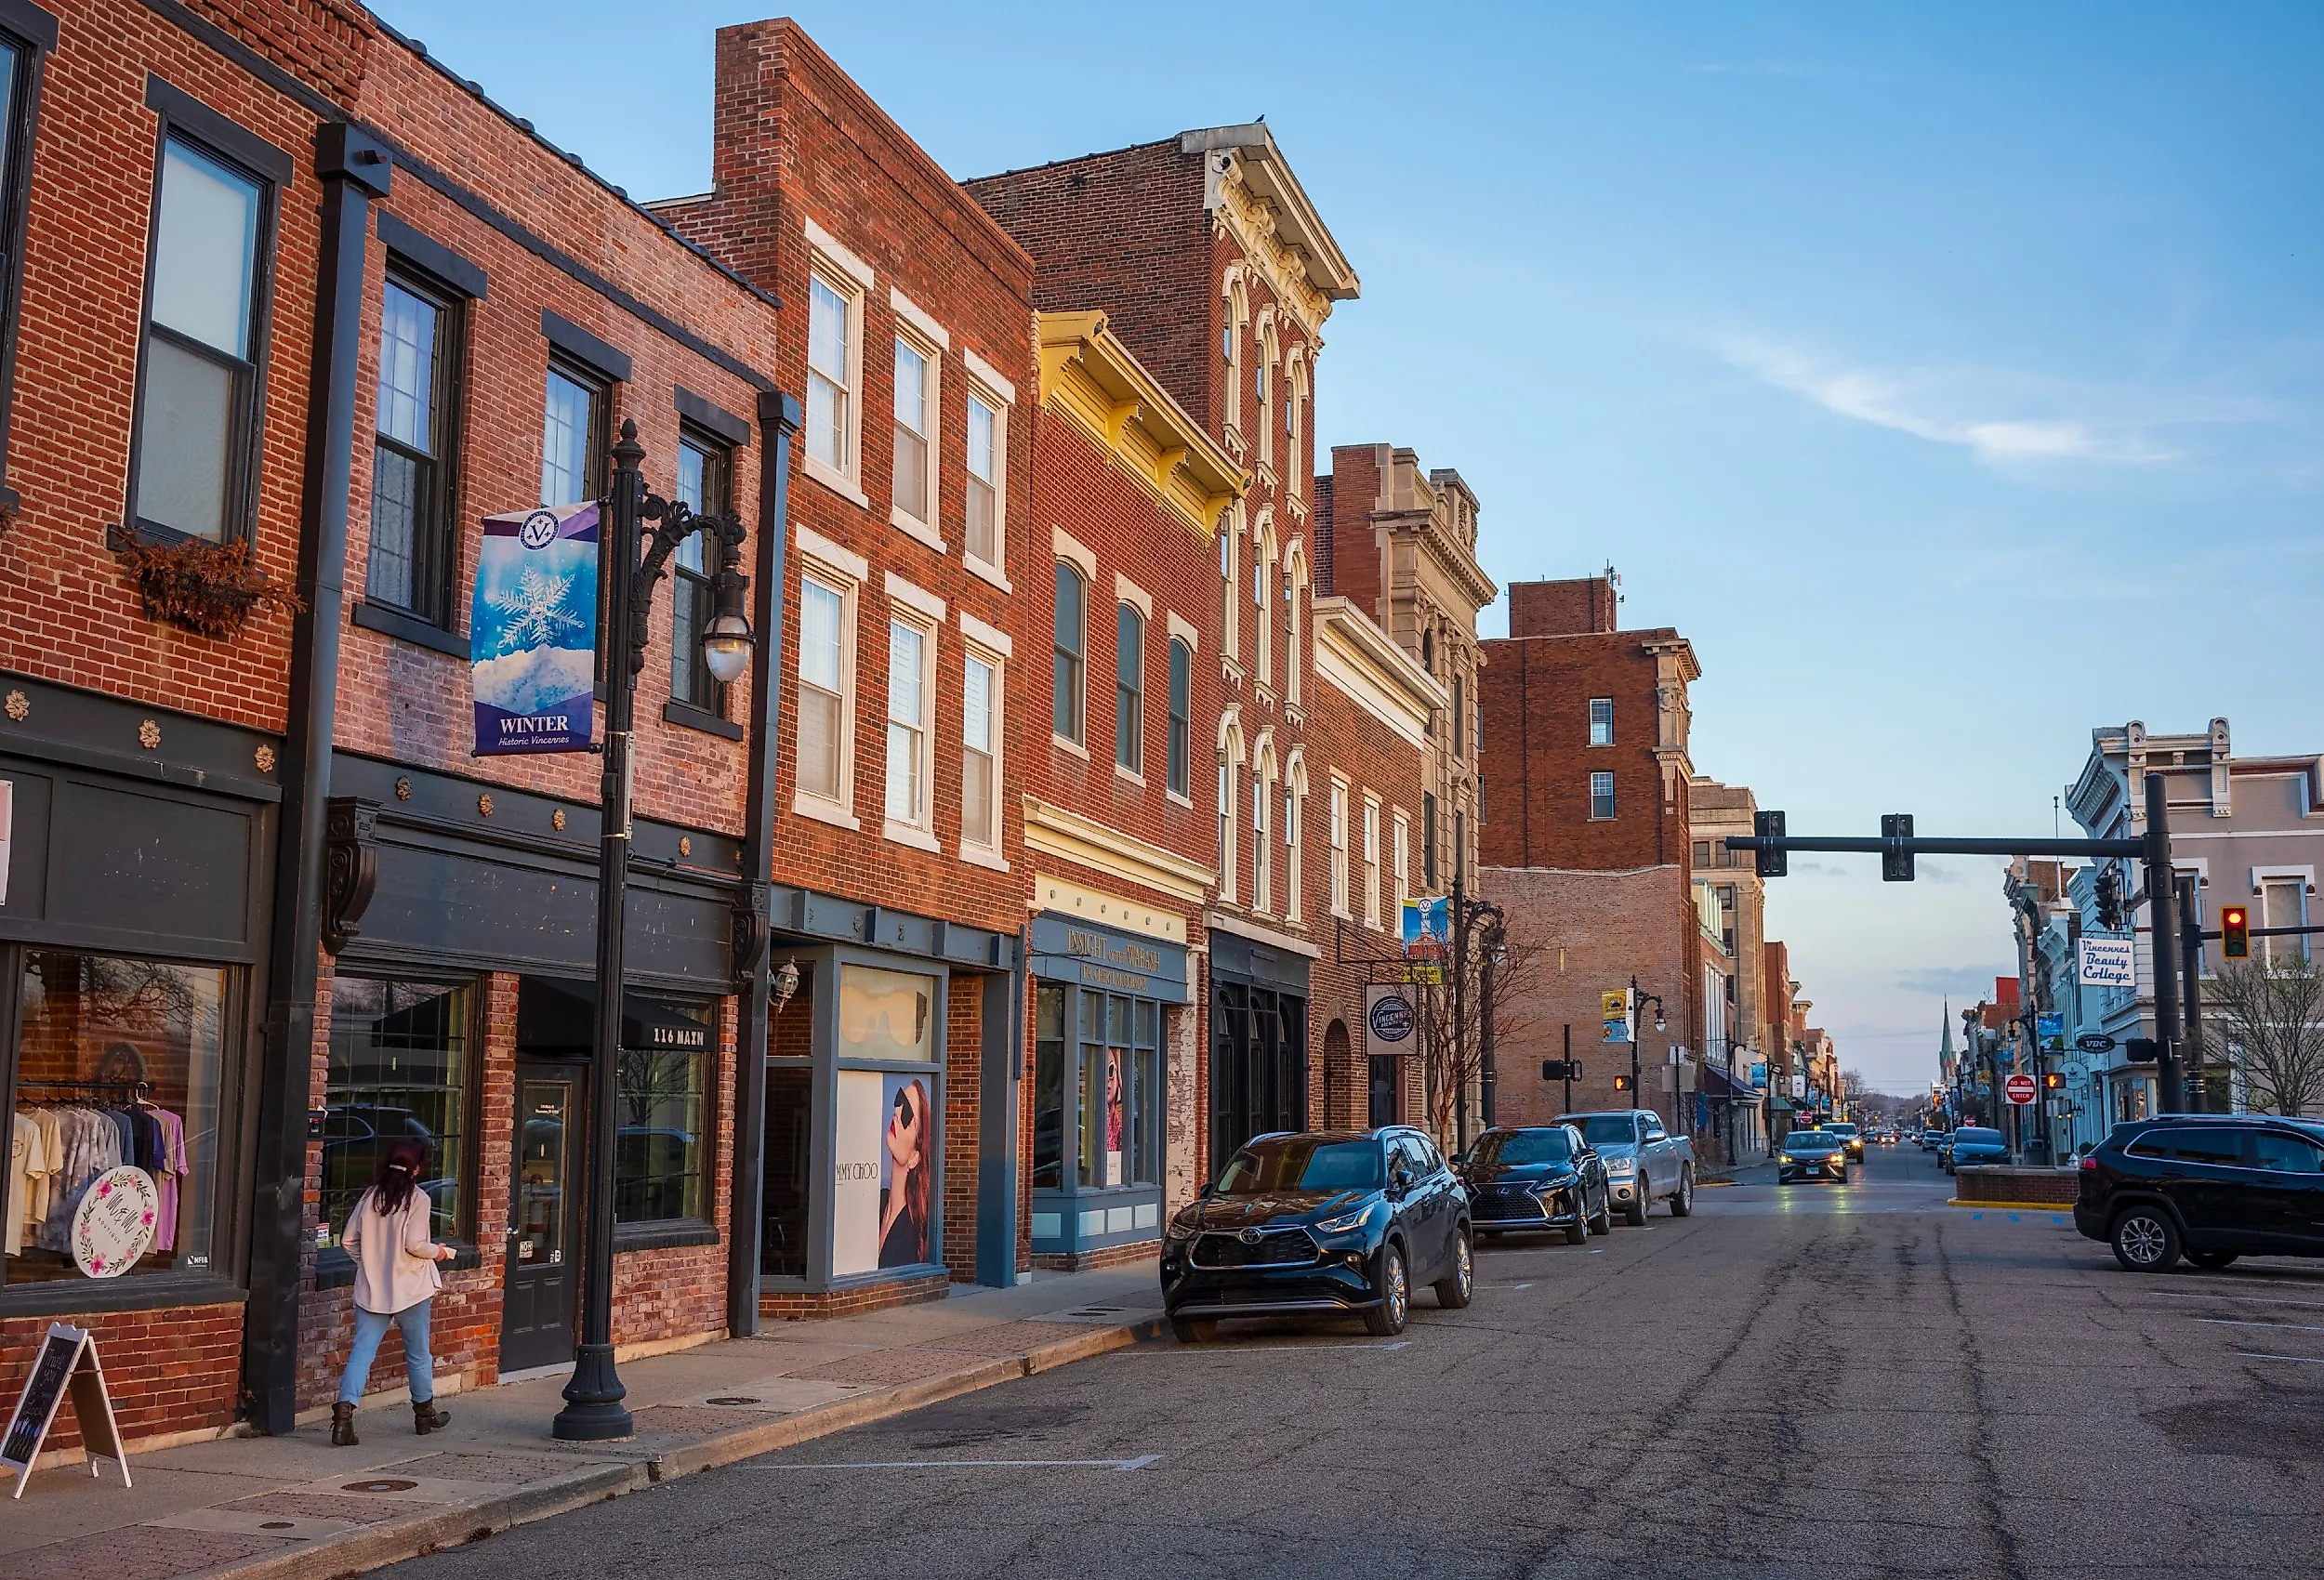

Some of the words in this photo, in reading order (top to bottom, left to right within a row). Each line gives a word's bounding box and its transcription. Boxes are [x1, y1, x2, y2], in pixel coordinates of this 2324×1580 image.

[530, 521, 550, 543] V
[500, 715, 570, 734] WINTER
[498, 737, 530, 746] Historic
[531, 735, 570, 744] Vincennes
[1067, 928, 1107, 960] INSIGHT
[1127, 944, 1161, 972] WABASH
[2081, 940, 2132, 954] Vincennes
[2085, 952, 2128, 969] Beauty
[2082, 965, 2132, 984] College
[654, 1027, 674, 1044] 116
[677, 1030, 705, 1047] MAIN
[837, 1163, 852, 1181] MMY
[852, 1162, 878, 1180] CHOO
[97, 1217, 121, 1244] BOUTIQUE
